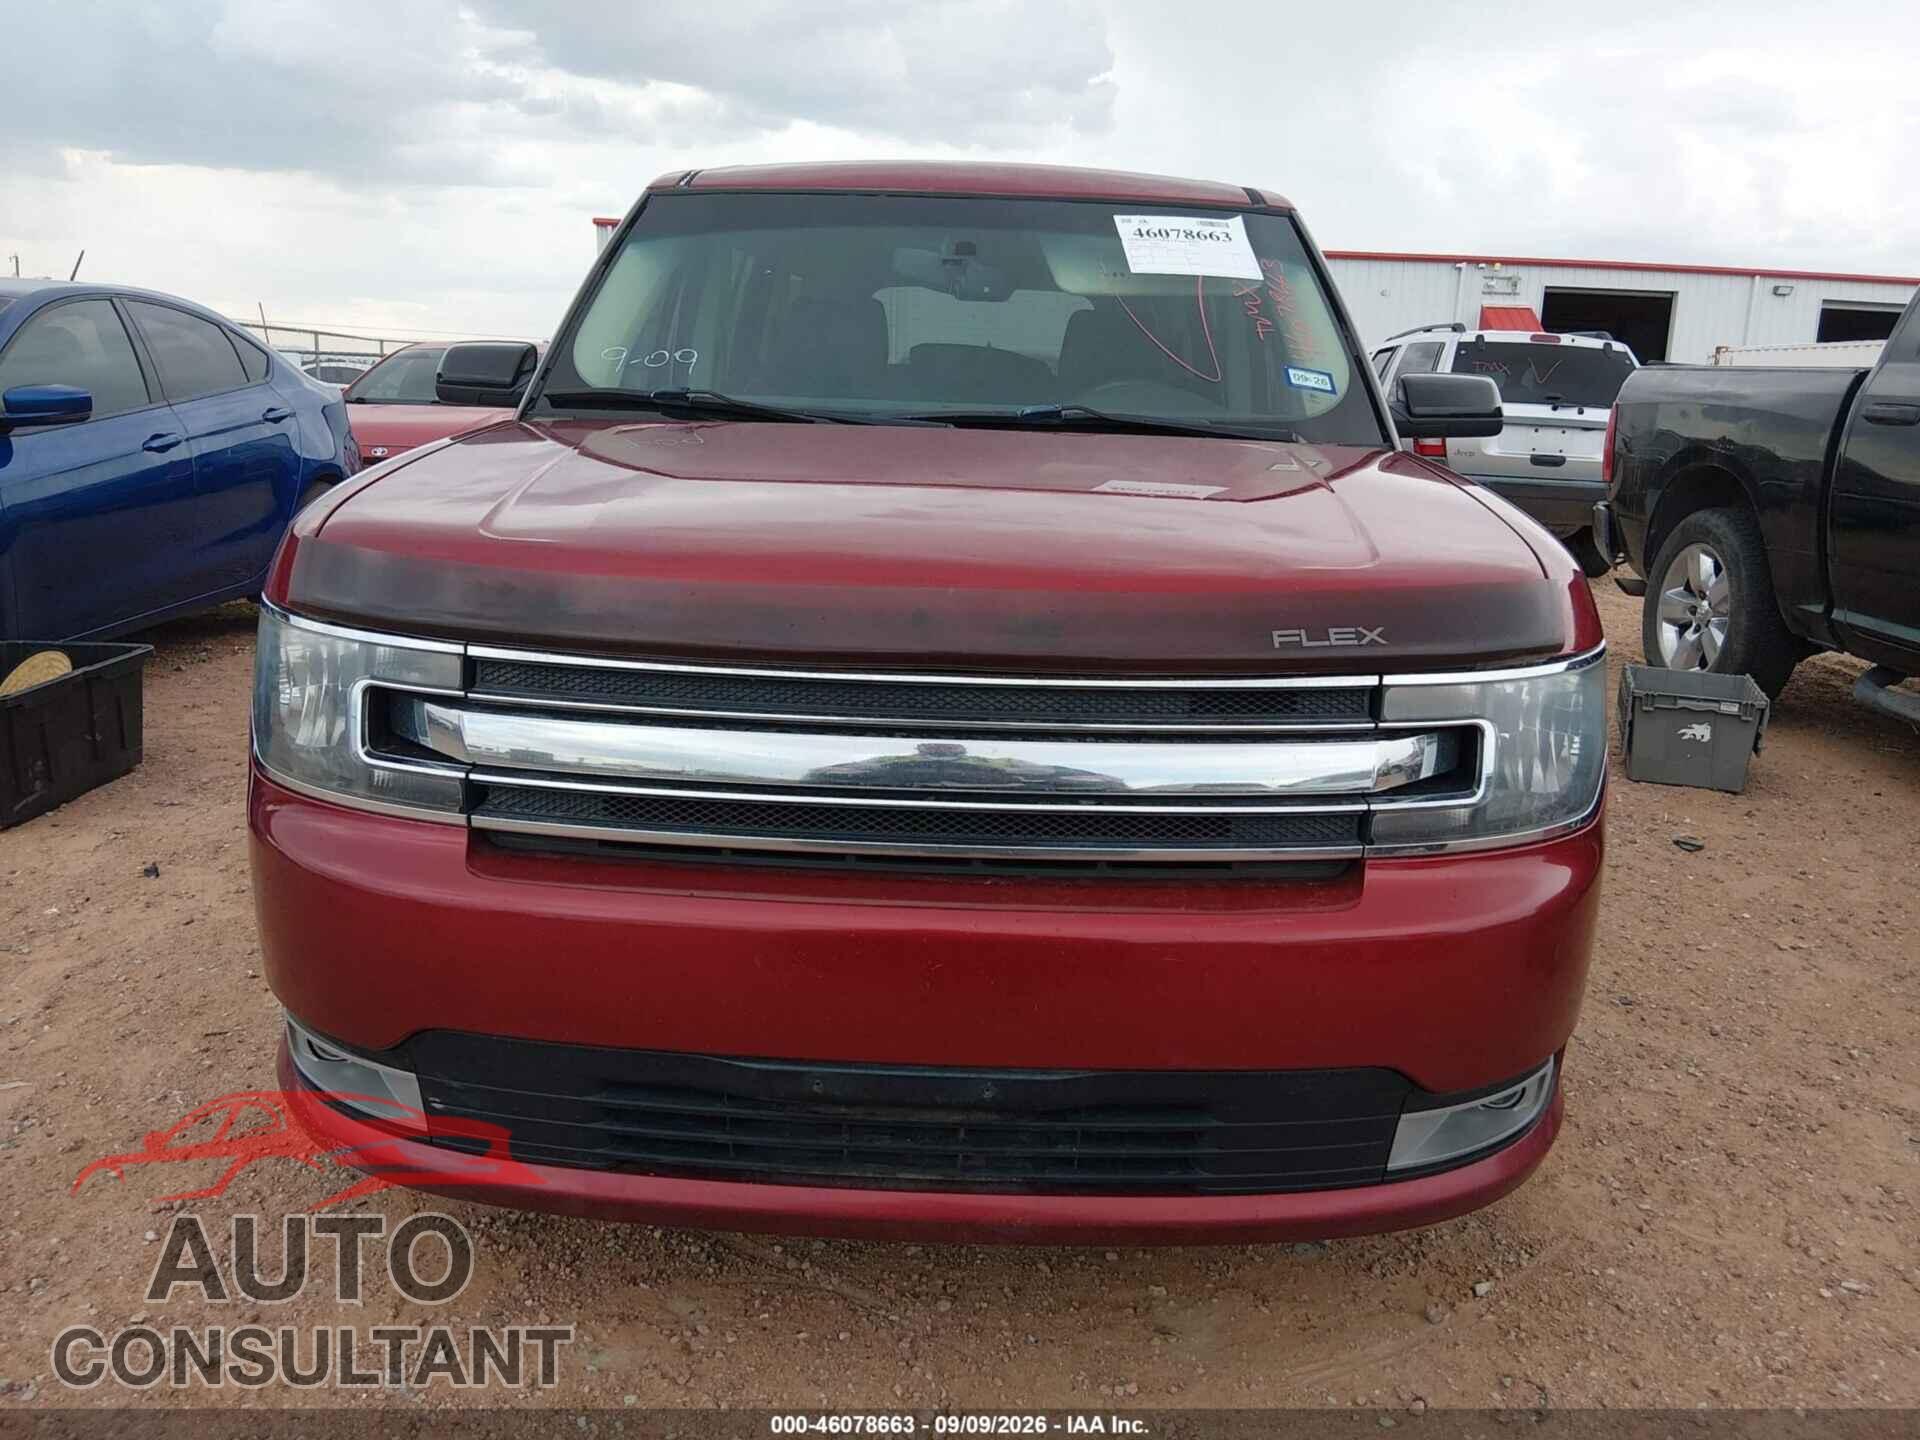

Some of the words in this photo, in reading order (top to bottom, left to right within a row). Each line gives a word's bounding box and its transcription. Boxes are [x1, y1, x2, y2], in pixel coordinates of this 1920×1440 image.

[1132, 227, 1233, 243] 46078663
[600, 346, 699, 376] 9-09
[1271, 626, 1388, 649] FLEX
